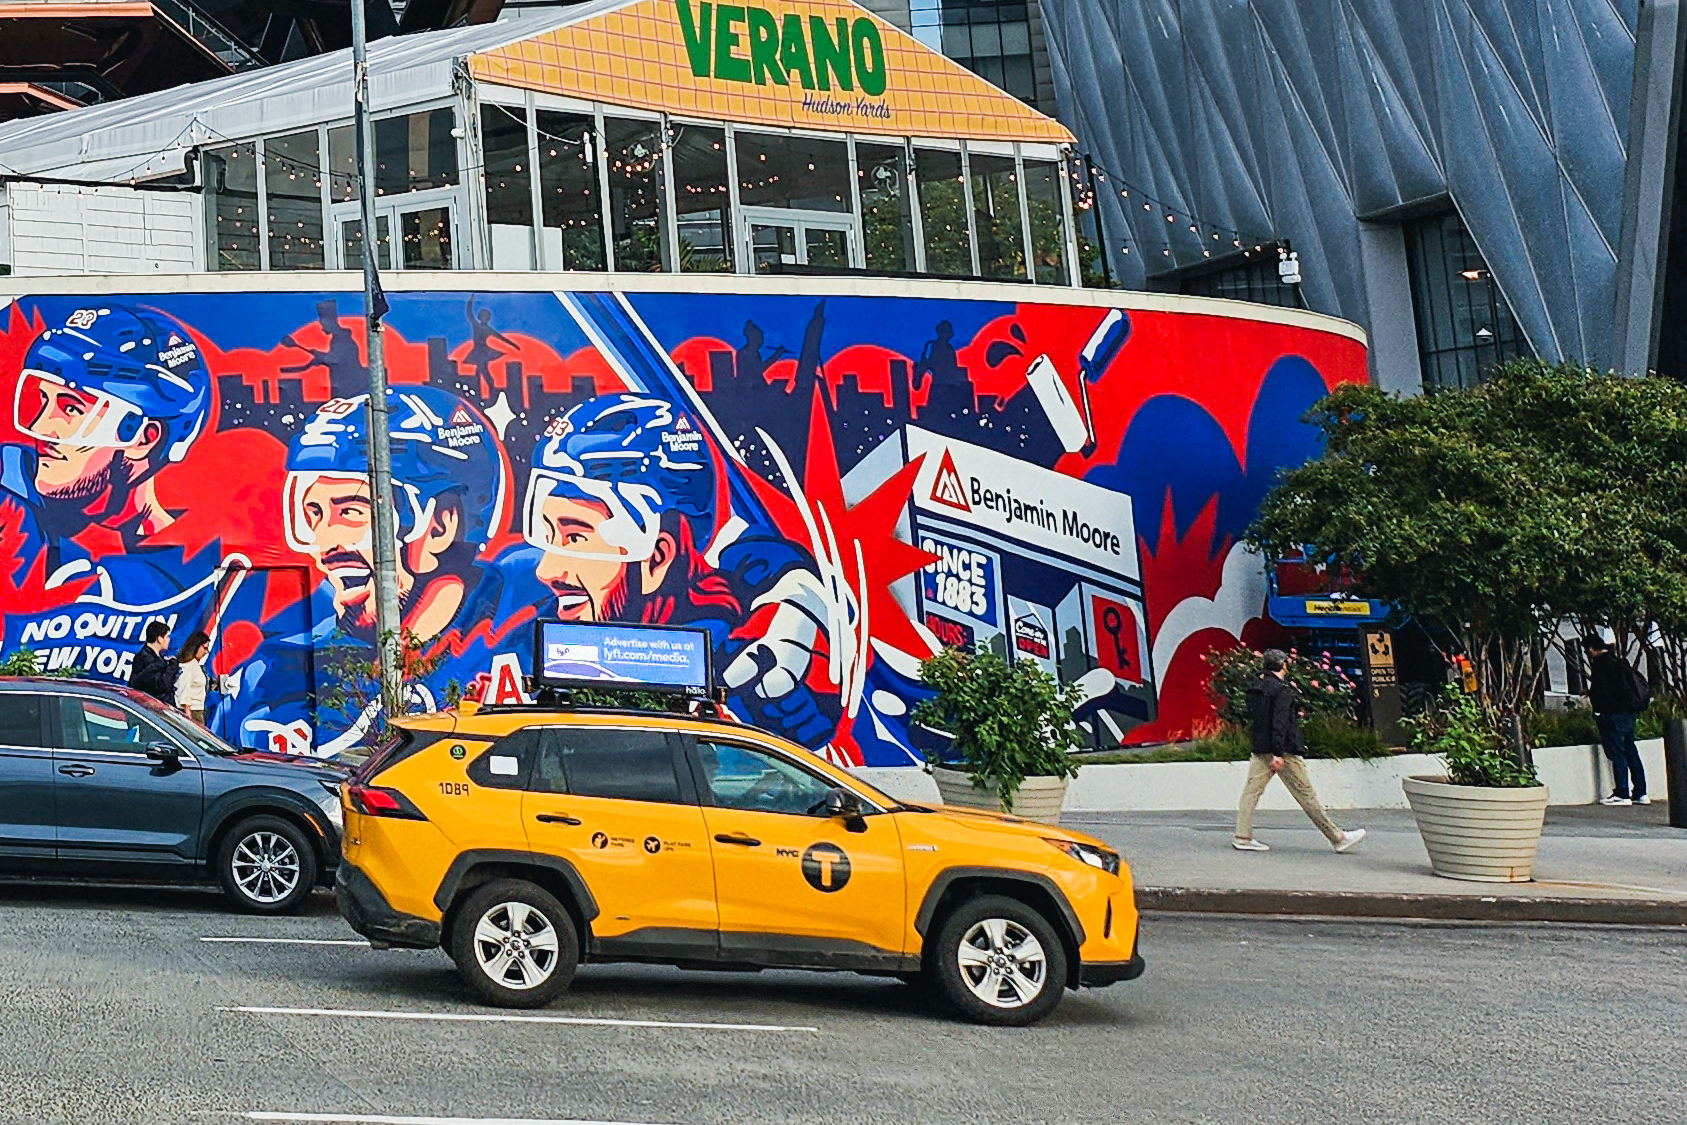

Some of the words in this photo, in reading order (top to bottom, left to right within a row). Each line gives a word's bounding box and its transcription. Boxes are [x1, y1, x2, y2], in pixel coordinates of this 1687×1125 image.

[801, 92, 853, 116] Hudson
[854, 96, 891, 119] Yards
[158, 342, 197, 363] Benjamin
[167, 351, 196, 369] Moore
[437, 423, 484, 440] Benjamin
[661, 430, 703, 444] Benjamin
[447, 435, 481, 448] Moore
[669, 441, 699, 452] Moore
[969, 476, 1058, 534] Benjamin
[1062, 508, 1121, 556] Moore
[922, 538, 987, 586] SINCE
[935, 572, 987, 616] 1883
[20, 614, 72, 643] NO
[73, 612, 143, 640] QUIT
[604, 637, 649, 648] Advertise
[649, 639, 671, 650] with
[671, 642, 683, 651] us
[683, 642, 695, 651] at
[31, 645, 82, 675] EW
[82, 645, 136, 681] YOR
[604, 647, 691, 664] lyft.com/media.
[492, 659, 527, 705] A
[438, 782, 470, 797] 1D89
[776, 847, 800, 858] NYC
